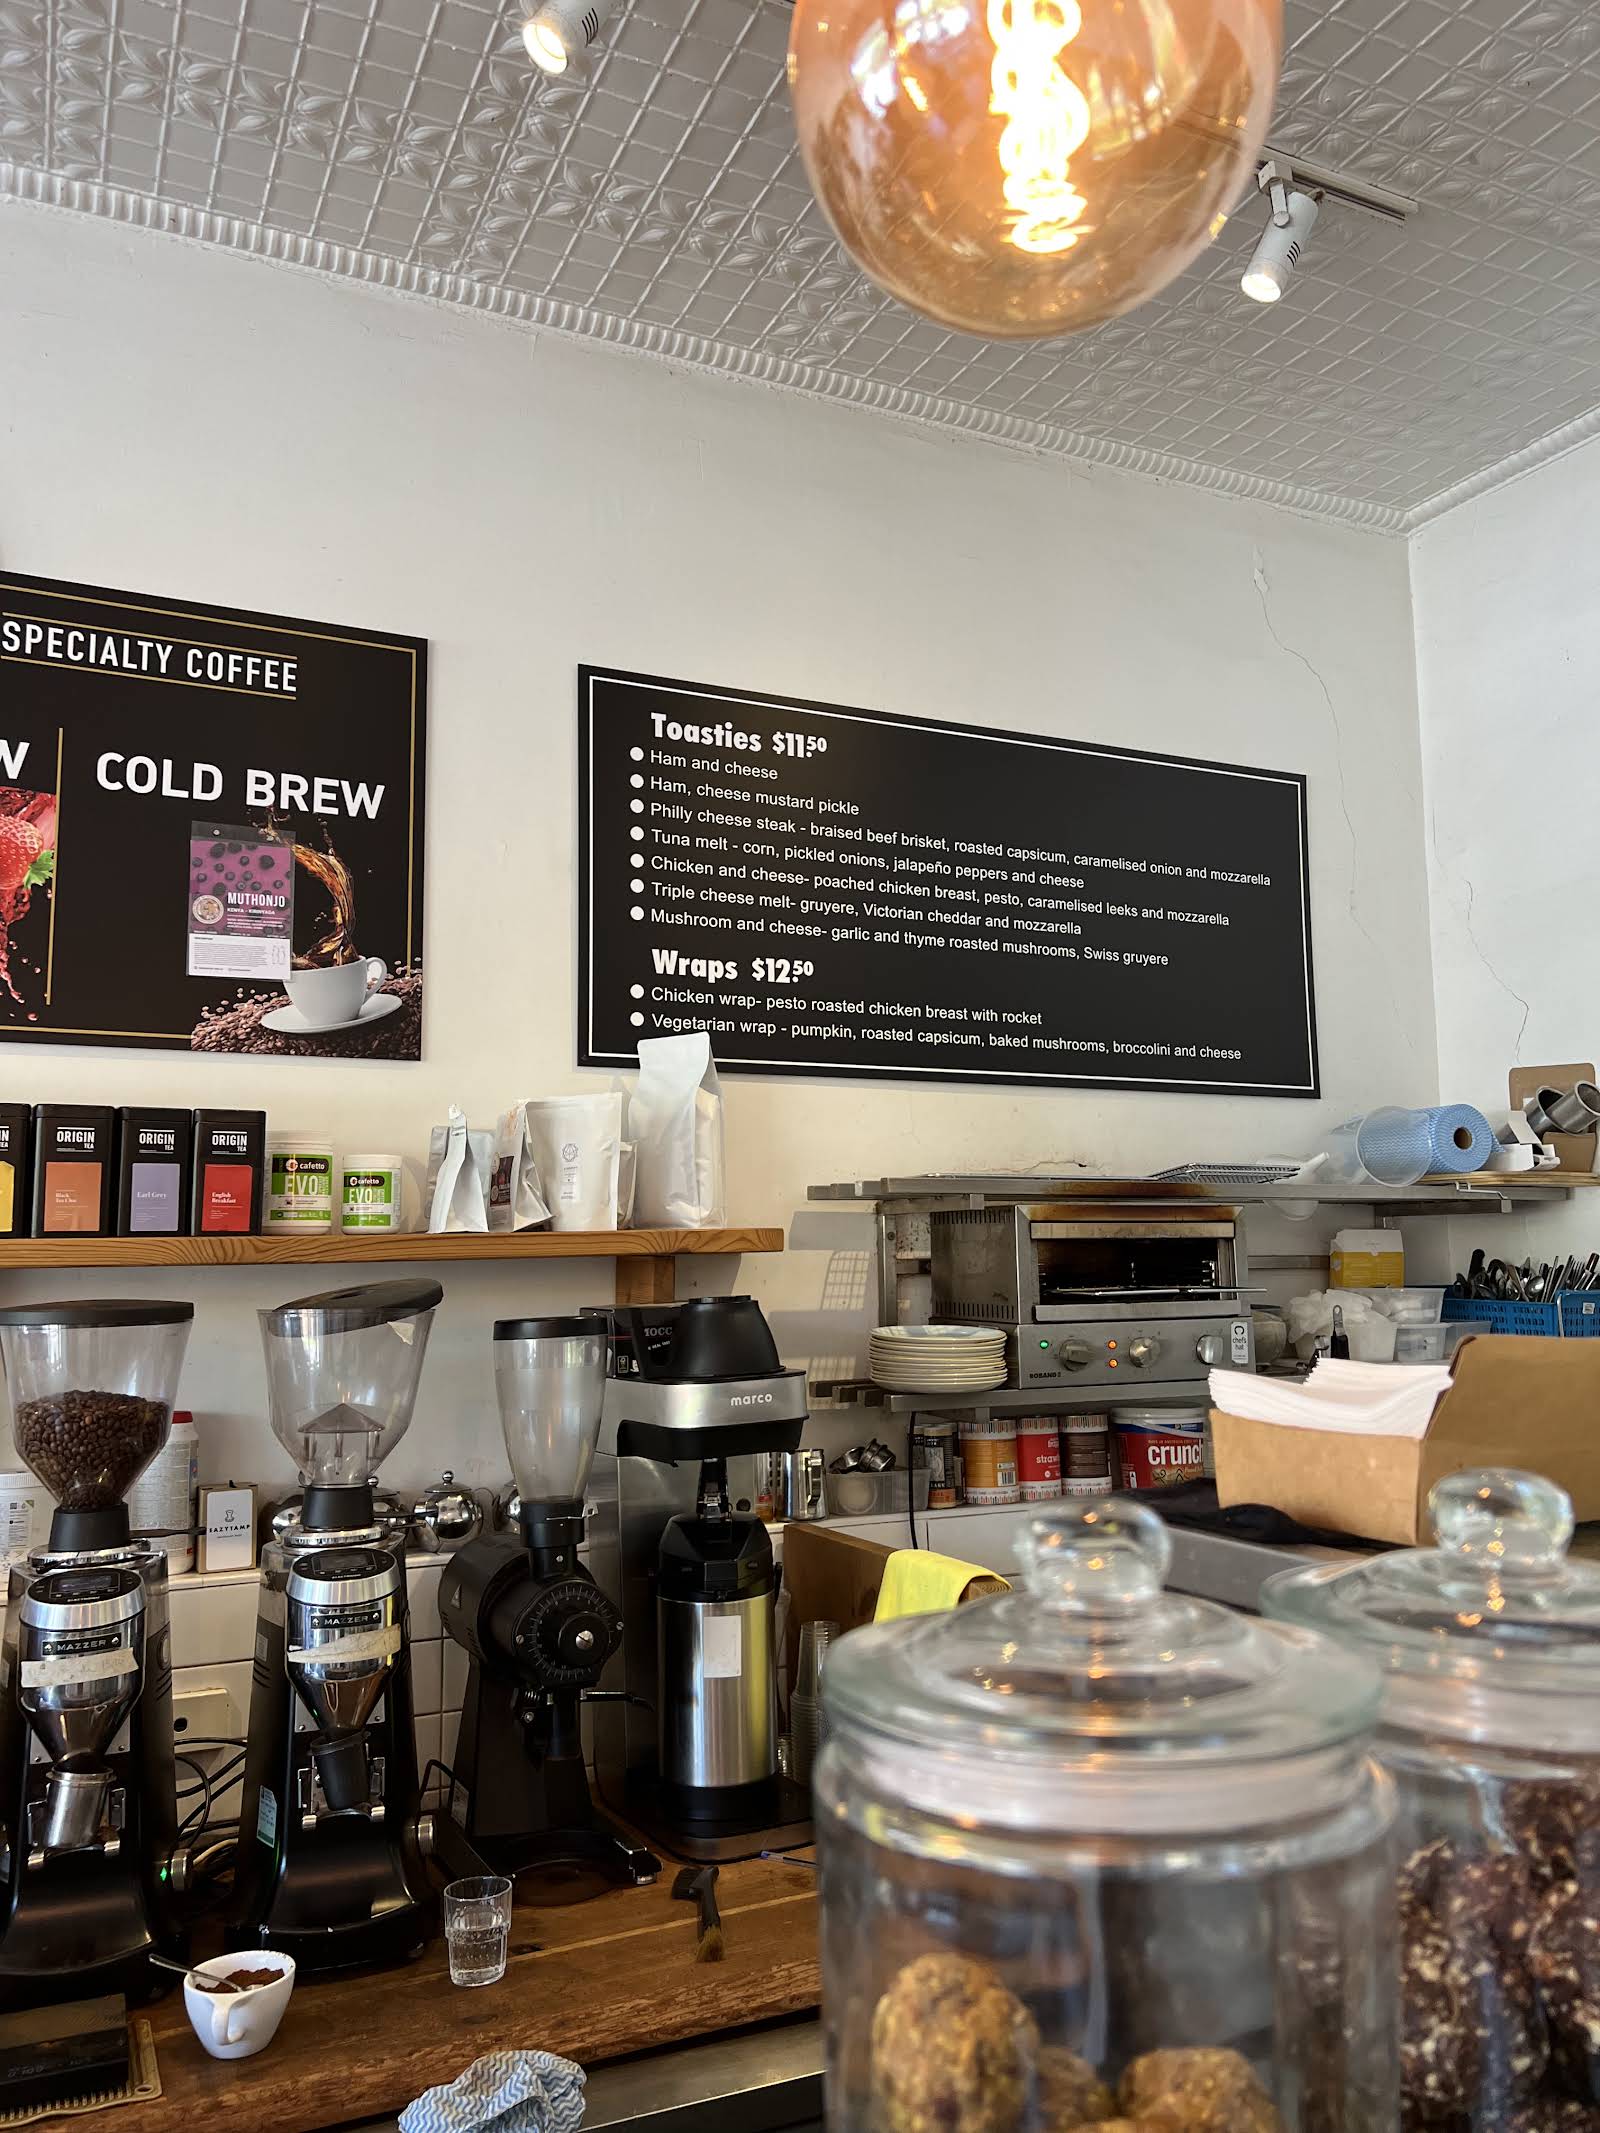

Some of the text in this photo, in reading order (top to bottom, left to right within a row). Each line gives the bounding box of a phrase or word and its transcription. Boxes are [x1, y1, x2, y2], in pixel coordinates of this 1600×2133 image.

[2, 620, 298, 691] SPECIALTY COFFEE
[651, 712, 827, 758] Toasties $11.50
[651, 750, 778, 780] Ham and cheese
[97, 752, 385, 820] COLD BREW
[651, 776, 859, 815] Ham, cheese mustard pickle
[651, 802, 693, 823] Philly
[697, 809, 752, 827] cheese
[756, 817, 796, 833] steak
[811, 822, 862, 840] braised
[867, 829, 898, 844] beef
[901, 833, 950, 852] brisket,
[955, 842, 1003, 856] roasted
[1007, 848, 1069, 865] capsicum,
[1074, 855, 1146, 872] caramelised
[1150, 863, 1182, 876] onion
[1186, 867, 1207, 879] and
[1211, 871, 1270, 886] mozzarella
[651, 829, 690, 846] Tuna
[696, 837, 728, 851] melt
[743, 843, 779, 858] corn,
[785, 845, 834, 862] pickled
[839, 852, 889, 870] onions,
[893, 856, 951, 875] jalapeño
[956, 866, 1008, 881] peppers
[1012, 871, 1035, 883] and
[1039, 873, 1084, 888] cheese
[227, 892, 286, 907] MUTHONJO
[651, 856, 1229, 926] Chicken and cheese- poached chicken breast, pesto, caramelised leeks and mozzarella
[651, 882, 1081, 935] Triple cheese melt- gruyere, Victorian cheddar and mozzarella
[651, 908, 1168, 966] Mushroom and cheese- garlic and thyme roasted mushrooms, Swiss gruyere
[651, 949, 814, 983] Wraps $12.50
[651, 987, 1042, 1025] Chicken wrap- pesto roasted chicken breast with rocket
[651, 1013, 735, 1032] Vegetarian
[740, 1022, 776, 1037] wrap
[792, 1024, 856, 1040] pumpkin,
[861, 1028, 913, 1041] roasted
[918, 1031, 984, 1047] capsicum,
[989, 1033, 1028, 1048] baked
[1033, 1037, 1109, 1054] mushrooms,
[1113, 1040, 1170, 1055] broccolini
[1174, 1045, 1196, 1057] and
[1200, 1046, 1241, 1059] cheese
[56, 1131, 95, 1143] ORIGIN
[139, 1133, 175, 1145] ORIGIN
[211, 1135, 248, 1146] ORIGIN
[299, 1161, 325, 1170] cafetto
[358, 1177, 380, 1185] cafetto
[285, 1175, 319, 1196] EVO
[349, 1188, 373, 1204] EVO
[730, 1392, 773, 1406] marco
[324, 1615, 369, 1625] MAZZER
[57, 1640, 106, 1651] MAZZER
